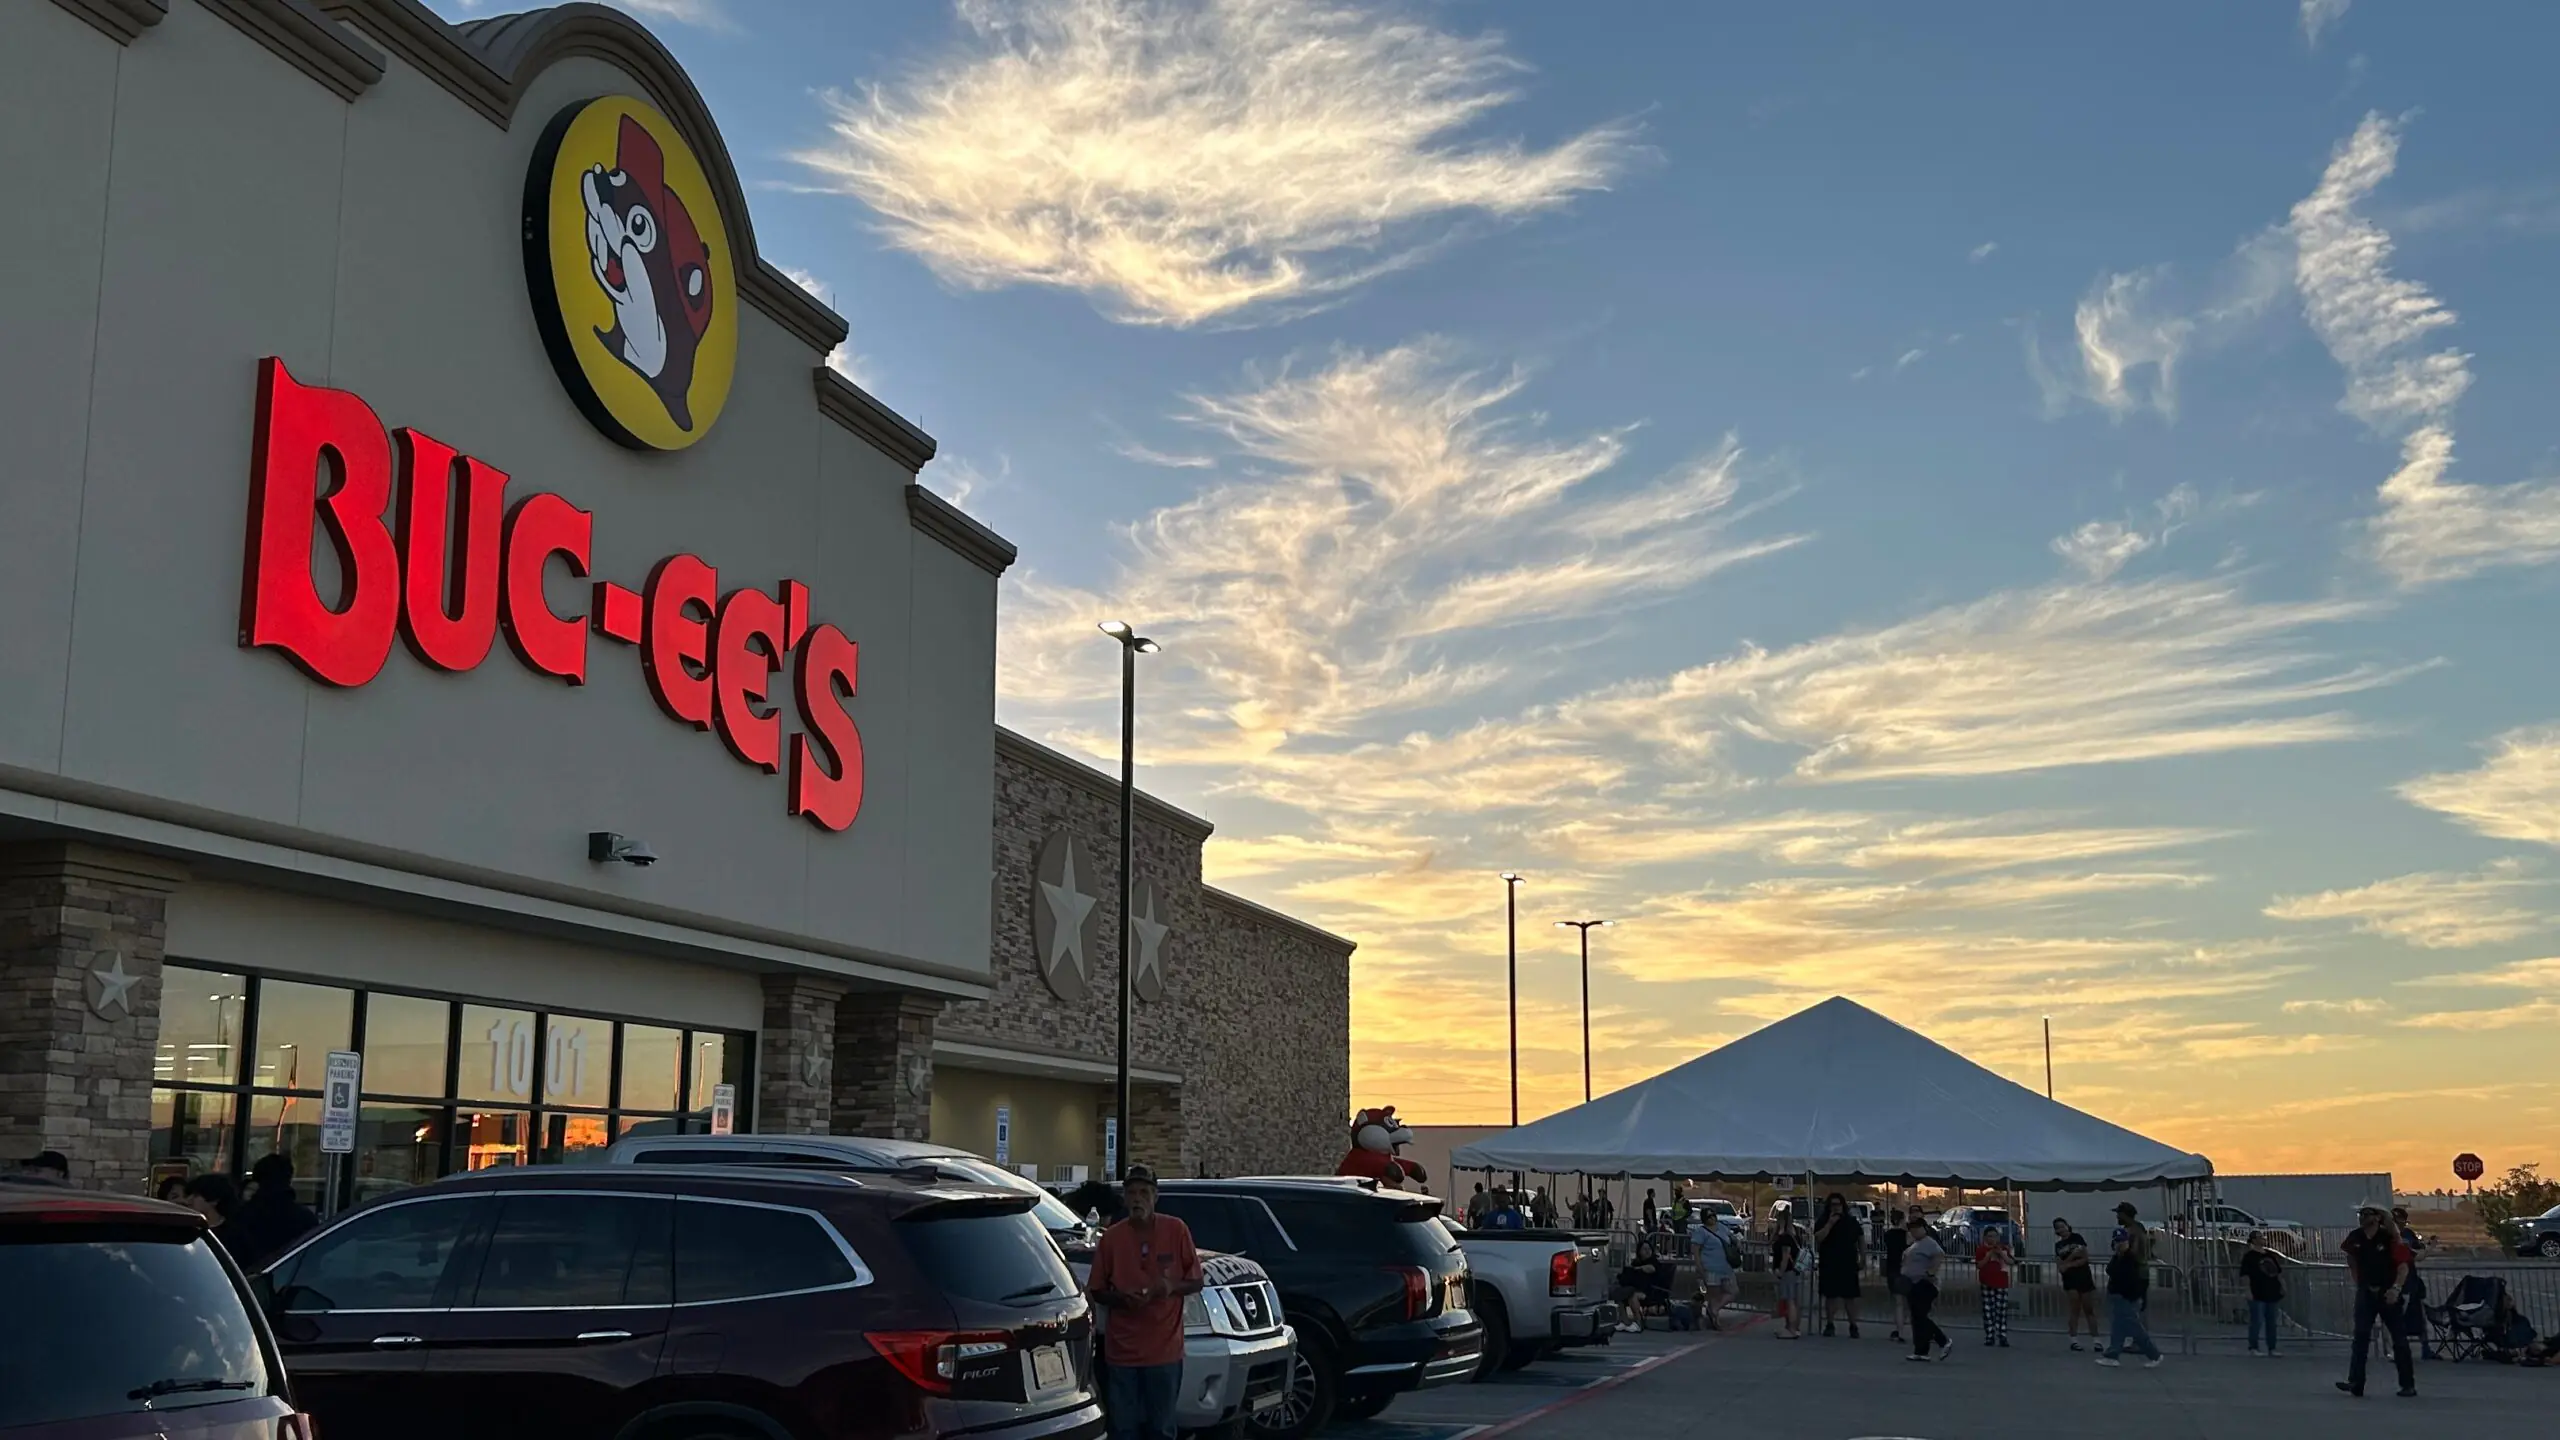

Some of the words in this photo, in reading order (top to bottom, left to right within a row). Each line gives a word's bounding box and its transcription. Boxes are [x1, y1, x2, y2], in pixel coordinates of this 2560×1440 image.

[239, 356, 864, 832] BUC-EE'S
[2455, 1161, 2482, 1172] STOP
[962, 1366, 1001, 1381] PILOT
